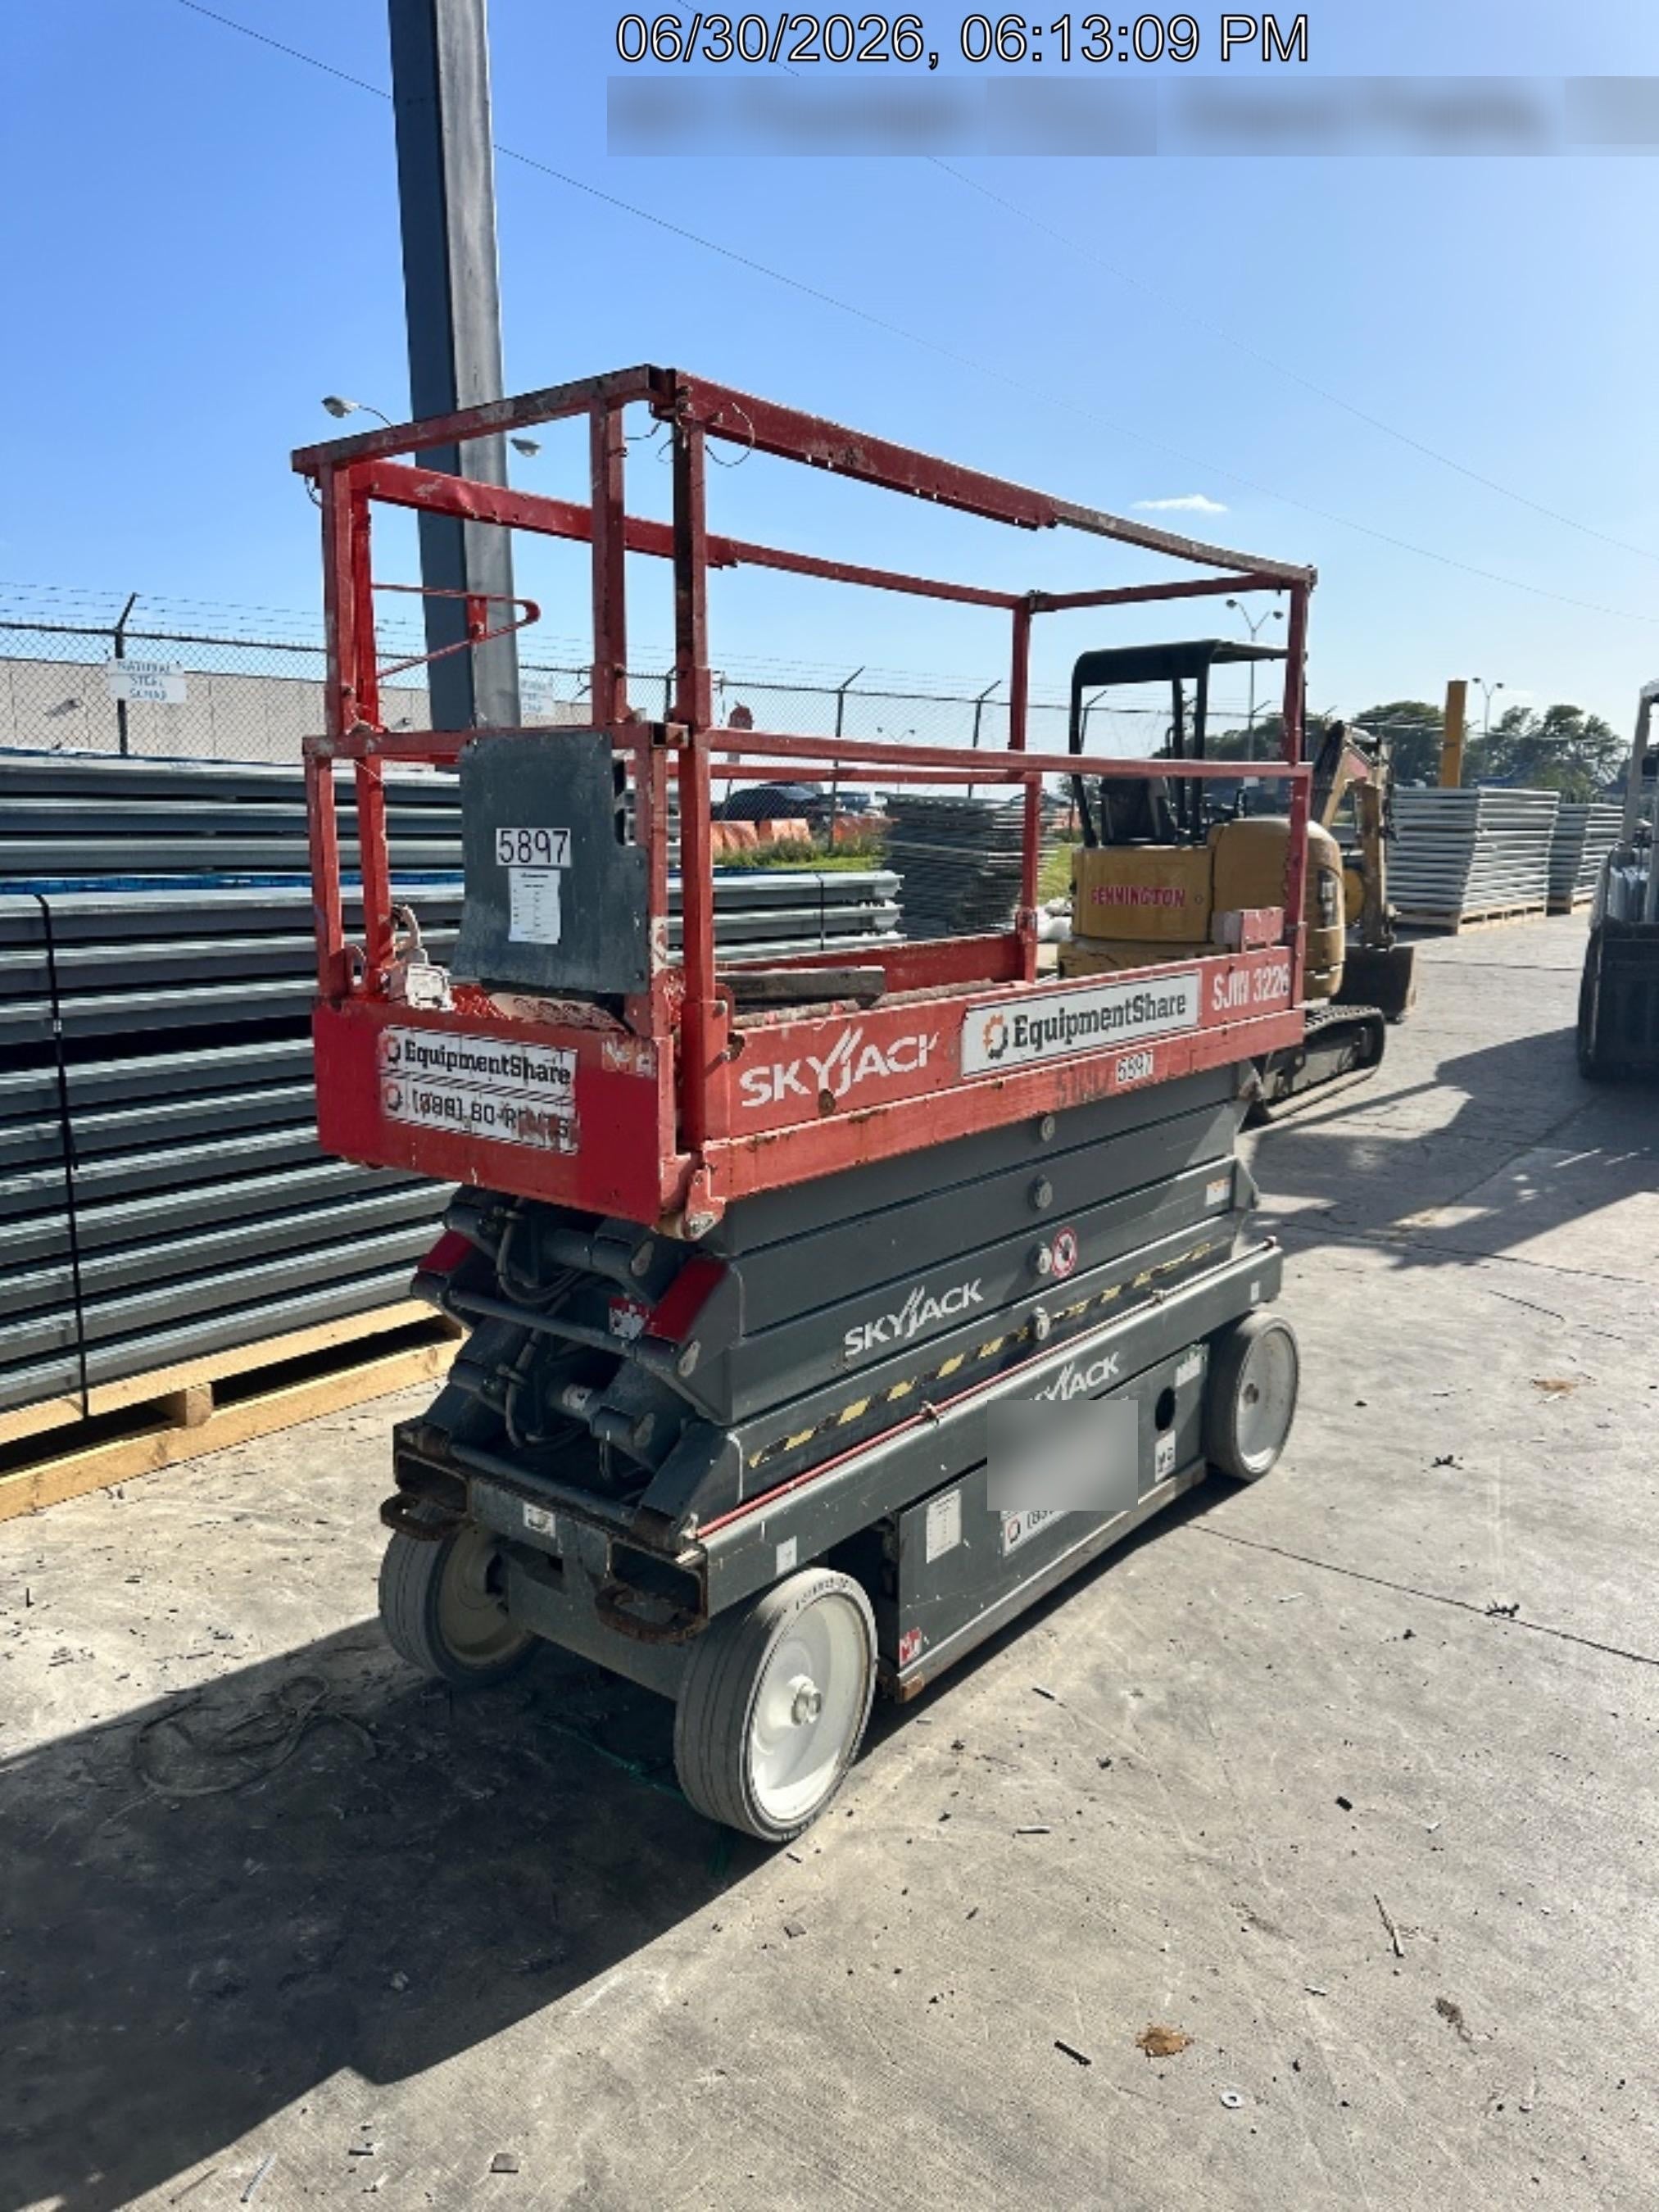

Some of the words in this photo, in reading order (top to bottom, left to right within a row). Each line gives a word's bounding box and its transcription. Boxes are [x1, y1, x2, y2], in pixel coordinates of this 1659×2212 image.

[497, 829, 569, 863] 5897
[1253, 963, 1290, 1003] 3226
[1012, 990, 1186, 1052] EquipmentShare
[405, 1039, 571, 1086] EquipmentShare
[844, 1277, 984, 1358] SKYJACK
